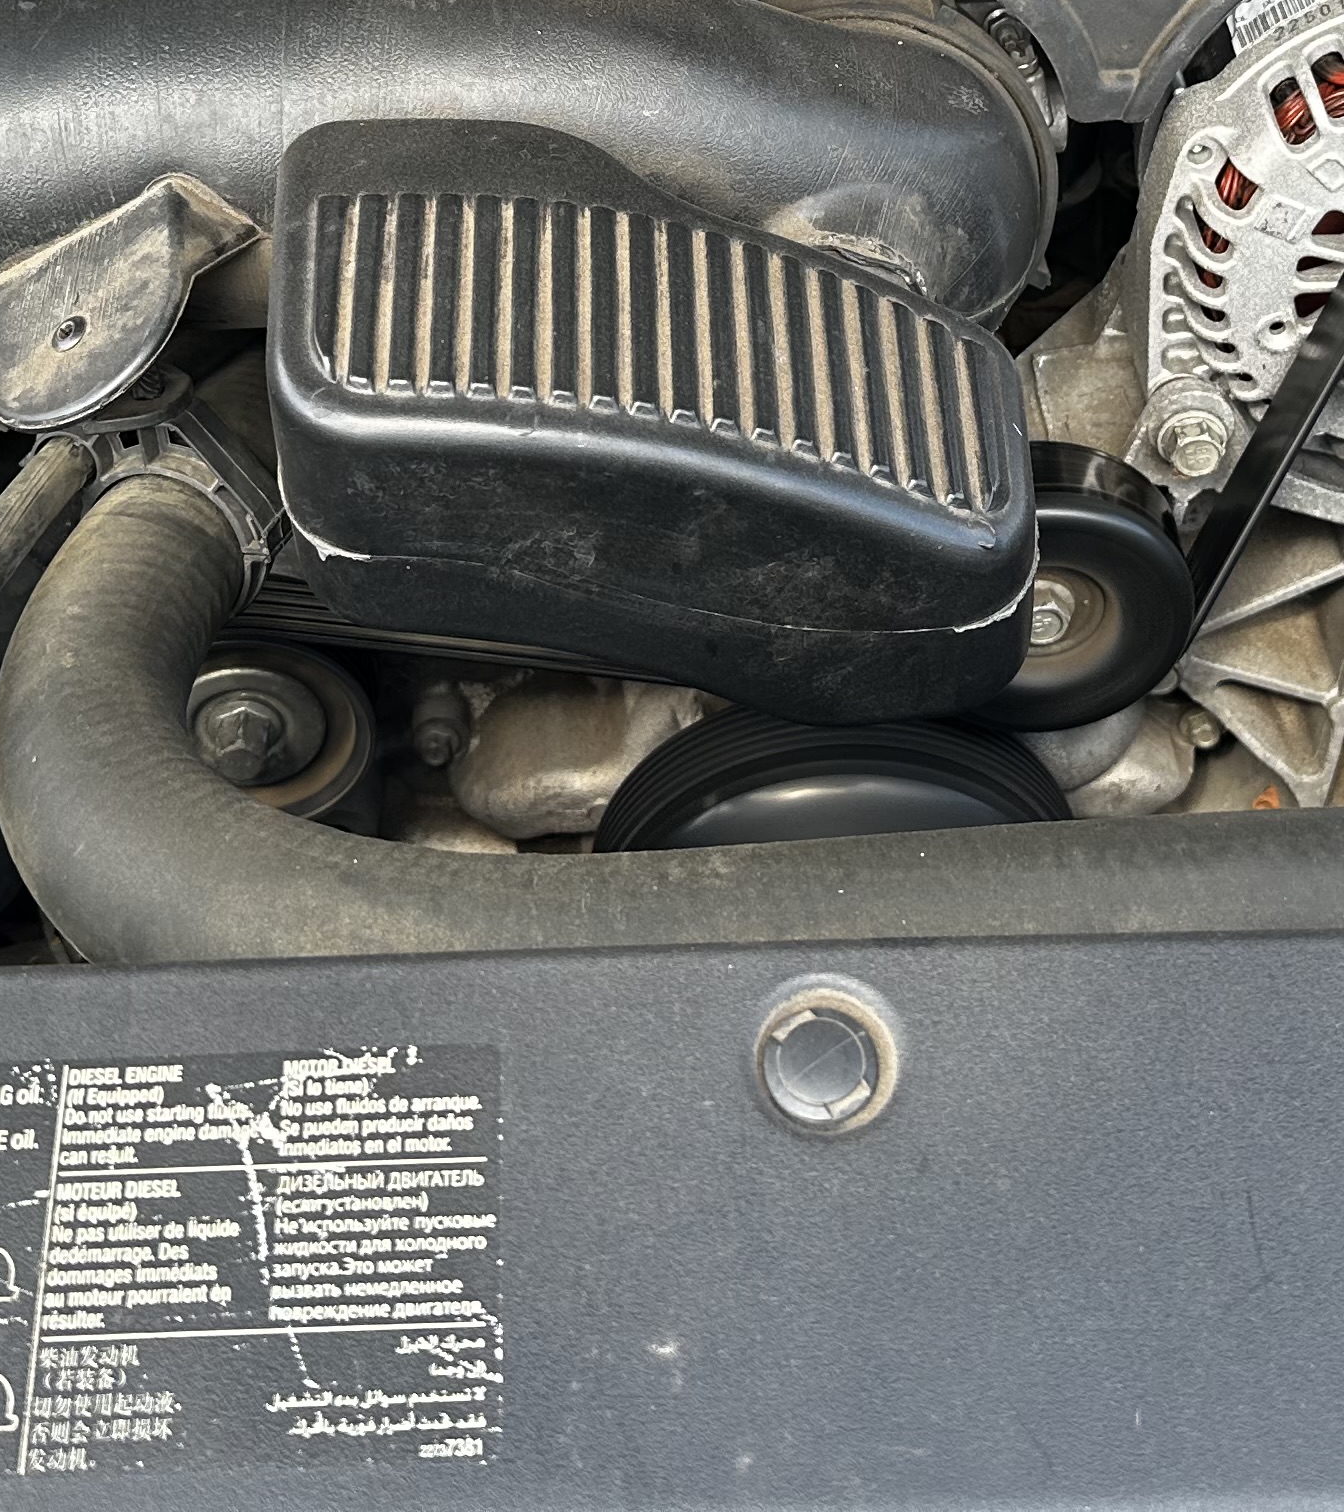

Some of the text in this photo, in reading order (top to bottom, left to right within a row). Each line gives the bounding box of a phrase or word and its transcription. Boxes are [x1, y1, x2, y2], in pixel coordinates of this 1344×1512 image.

[68, 1065, 184, 1086] DIESEL ENGINE
[64, 1107, 87, 1126] Do
[88, 1107, 114, 1125] not
[115, 1108, 144, 1123] use
[146, 1103, 205, 1124] starting
[280, 1098, 304, 1116] No
[305, 1100, 333, 1116] use
[335, 1096, 387, 1114] fluidos
[388, 1095, 409, 1112] de
[10, 1128, 39, 1150] oil.
[144, 1124, 196, 1146] engine
[280, 1118, 300, 1137] Se
[302, 1118, 359, 1139] pueden
[363, 1139, 384, 1154] en
[386, 1136, 402, 1153] el
[59, 1151, 88, 1166] can
[56, 1179, 181, 1201] MOTEUR DIESEL
[277, 1169, 486, 1194] ДИЗЕЛЬНЫЙ ДВИГАТЕЛЬ
[52, 1225, 74, 1243] Ne
[75, 1226, 105, 1245] pas
[163, 1221, 186, 1239] de
[274, 1218, 299, 1234] Не
[413, 1213, 497, 1233] пусковые
[158, 1242, 190, 1261] Des
[358, 1238, 392, 1255] для
[395, 1236, 487, 1254] холодного
[376, 1258, 434, 1274] может
[45, 1268, 133, 1287] dommages
[44, 1292, 65, 1308] au
[66, 1289, 124, 1308] moteur
[40, 1343, 140, 1368] 柴油发动机
